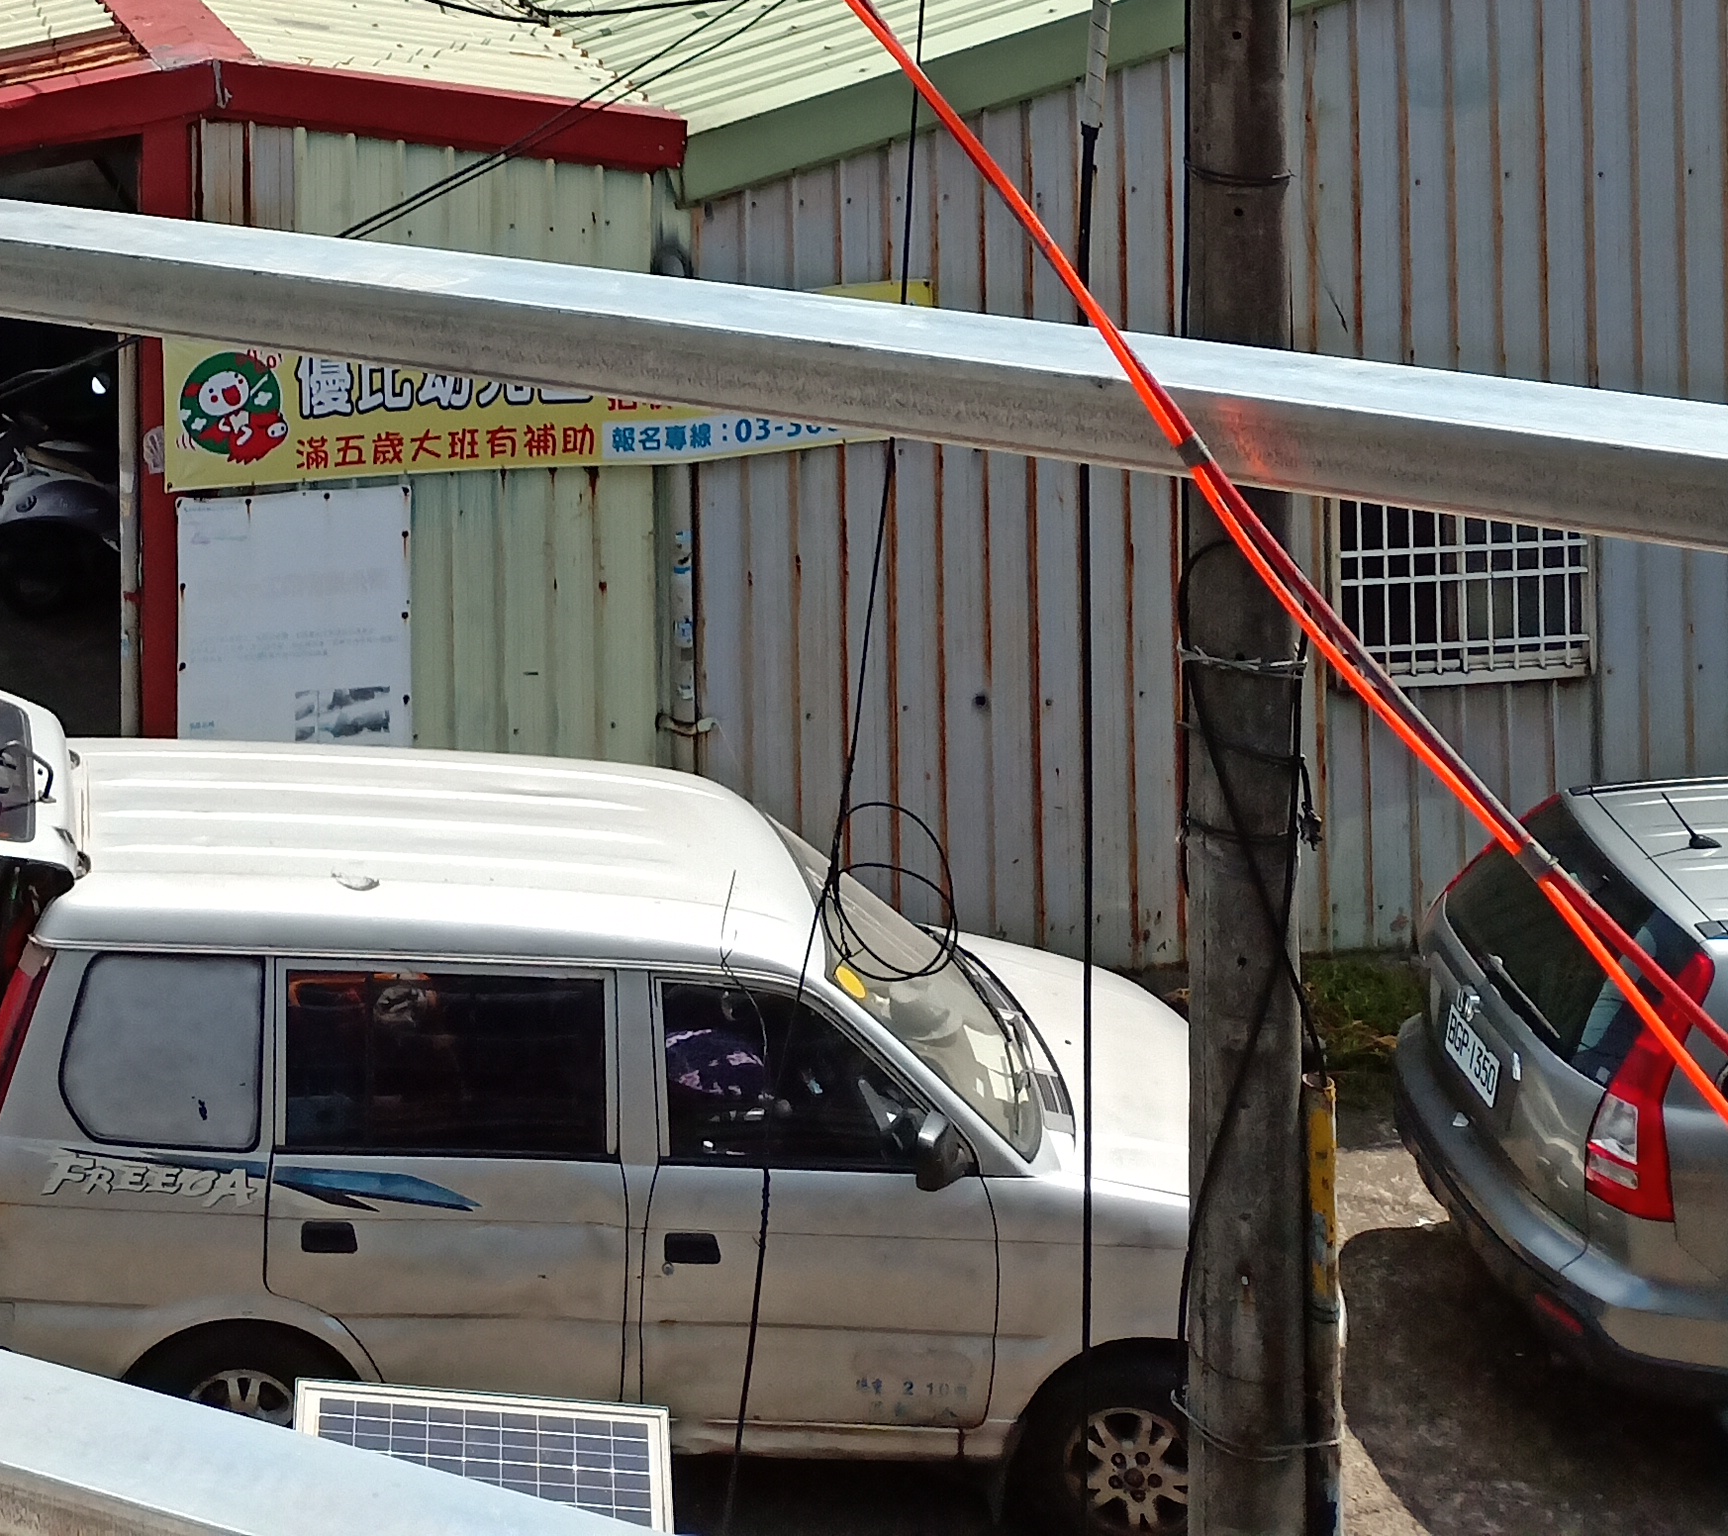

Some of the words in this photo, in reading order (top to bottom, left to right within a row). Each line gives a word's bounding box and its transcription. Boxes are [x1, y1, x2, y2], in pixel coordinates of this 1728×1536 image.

[294, 355, 594, 419] 優比幼
[295, 422, 595, 470] 滿五歲大班有補助
[1447, 1012, 1496, 1096] BGP-1350
